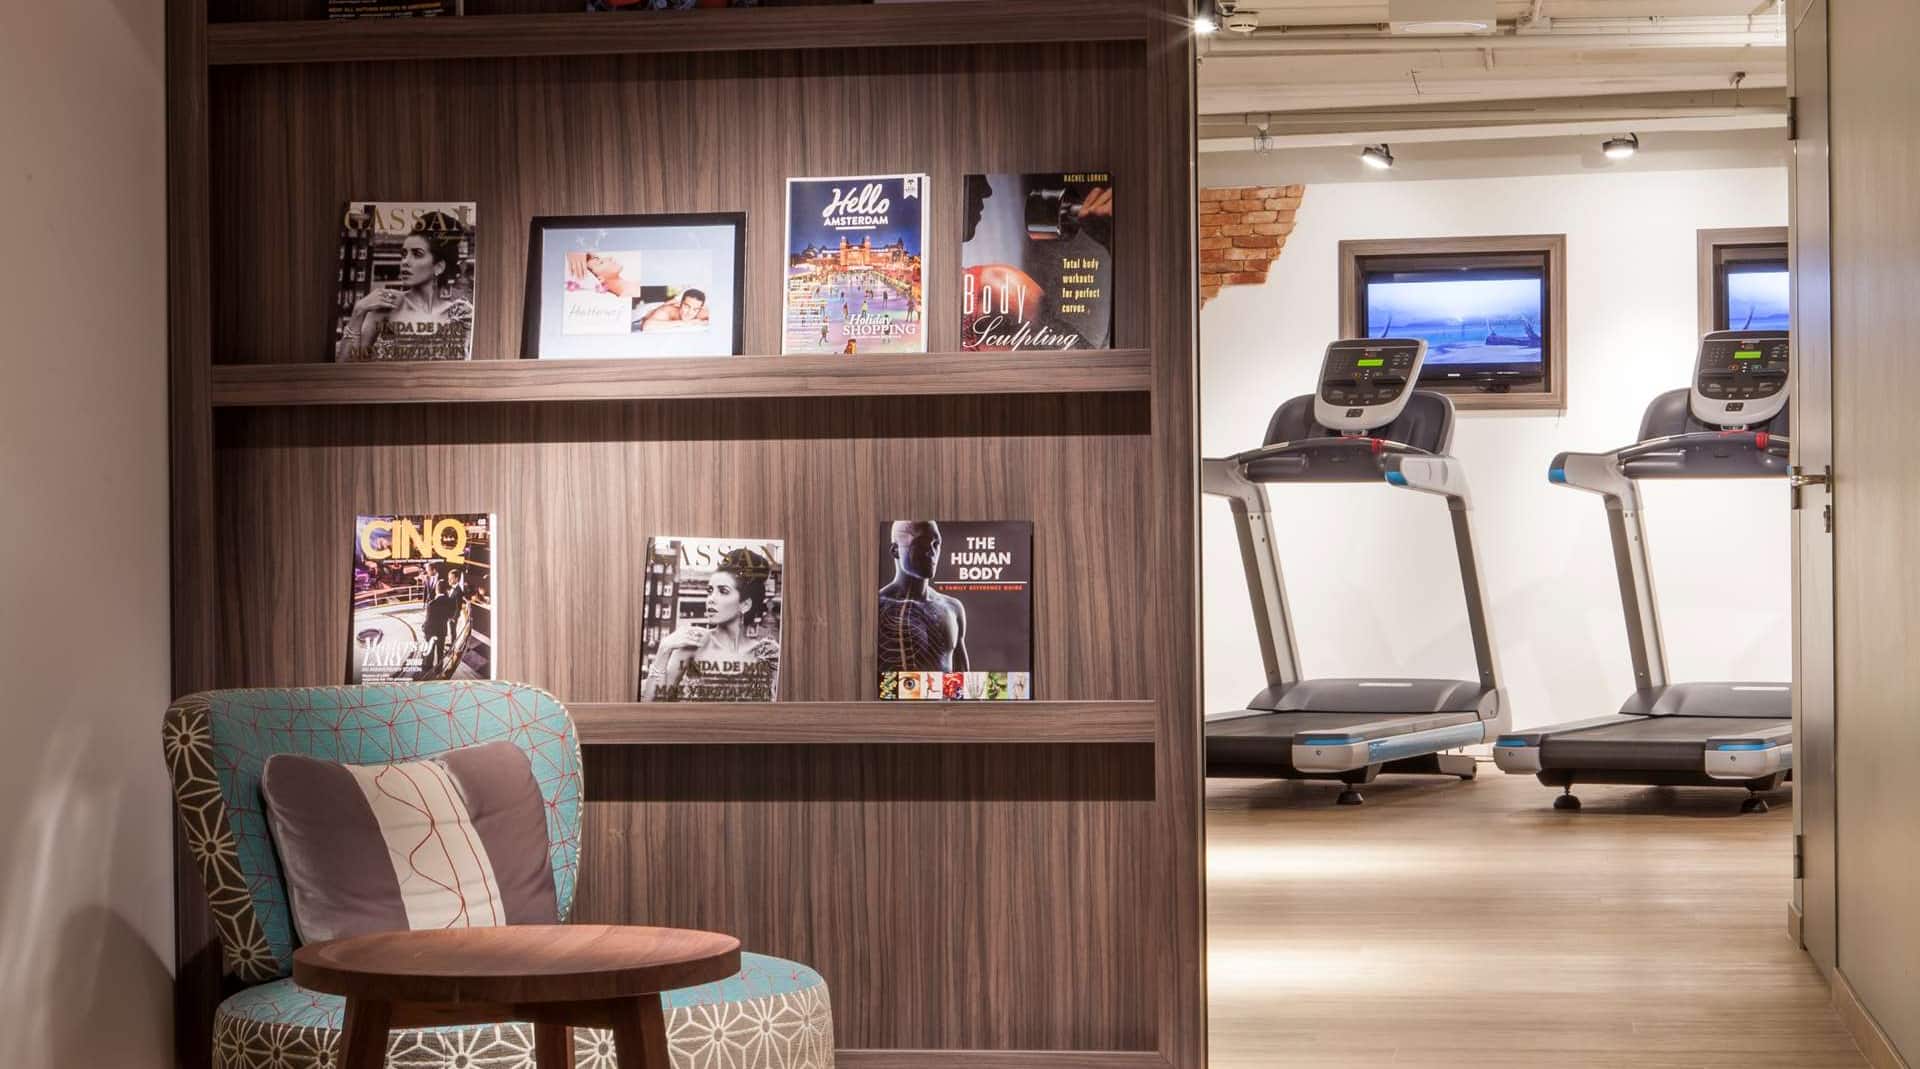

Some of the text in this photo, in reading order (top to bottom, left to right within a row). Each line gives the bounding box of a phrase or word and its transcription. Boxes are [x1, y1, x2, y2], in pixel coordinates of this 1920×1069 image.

[823, 183, 890, 218] Hello
[823, 216, 889, 227] AMSTERDAM
[1063, 258, 1099, 271] Total body
[1062, 274, 1095, 285] workouts
[963, 273, 1026, 324] Body
[1062, 287, 1101, 301] for perfect
[1062, 303, 1086, 314] curves
[849, 313, 892, 326] Holiday
[416, 321, 434, 333] DE
[842, 323, 917, 337] SHOPPING
[963, 315, 1080, 351] Sculpting
[360, 518, 467, 565] CINQ
[966, 536, 996, 549] THE
[951, 552, 1011, 565] HUMAN
[959, 567, 1003, 580] BODY
[723, 660, 741, 672] DE
